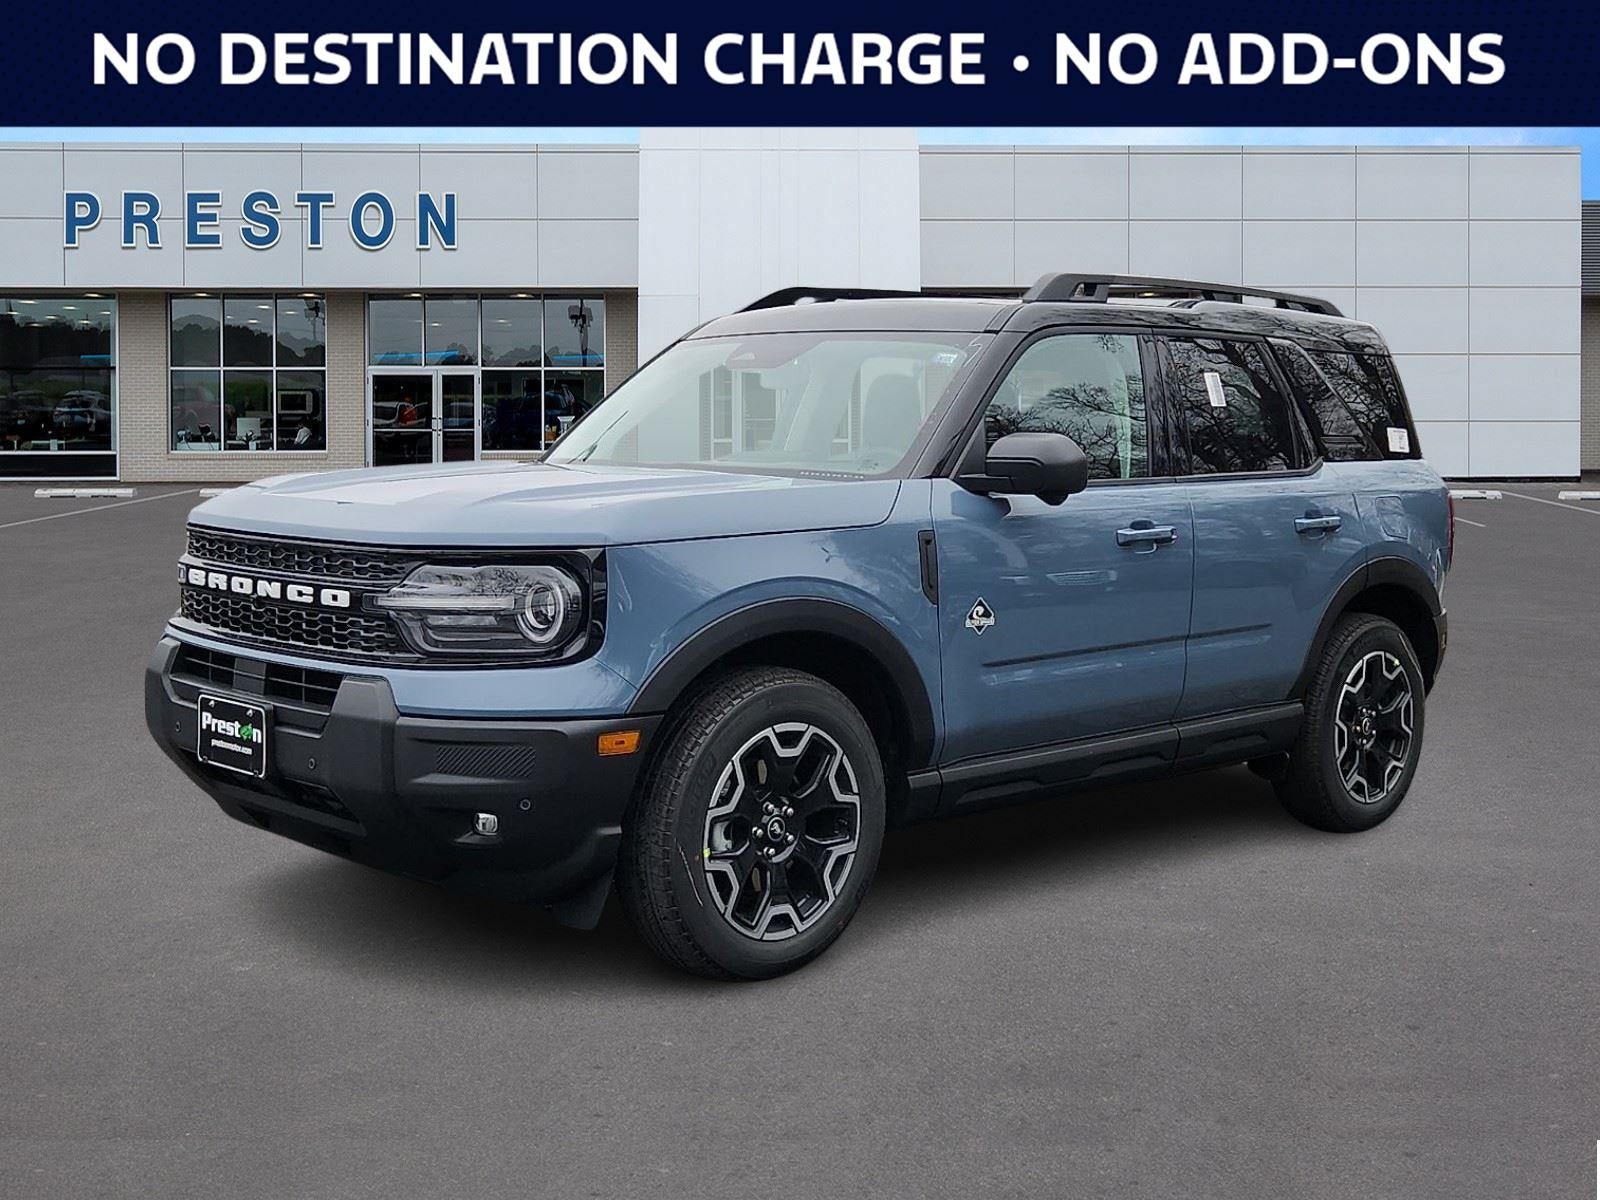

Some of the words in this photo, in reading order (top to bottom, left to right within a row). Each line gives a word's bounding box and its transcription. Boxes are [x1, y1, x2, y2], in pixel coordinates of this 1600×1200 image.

[64, 190, 459, 250] PRESTON
[188, 568, 350, 608] BRONCO
[201, 711, 262, 743] Preston
